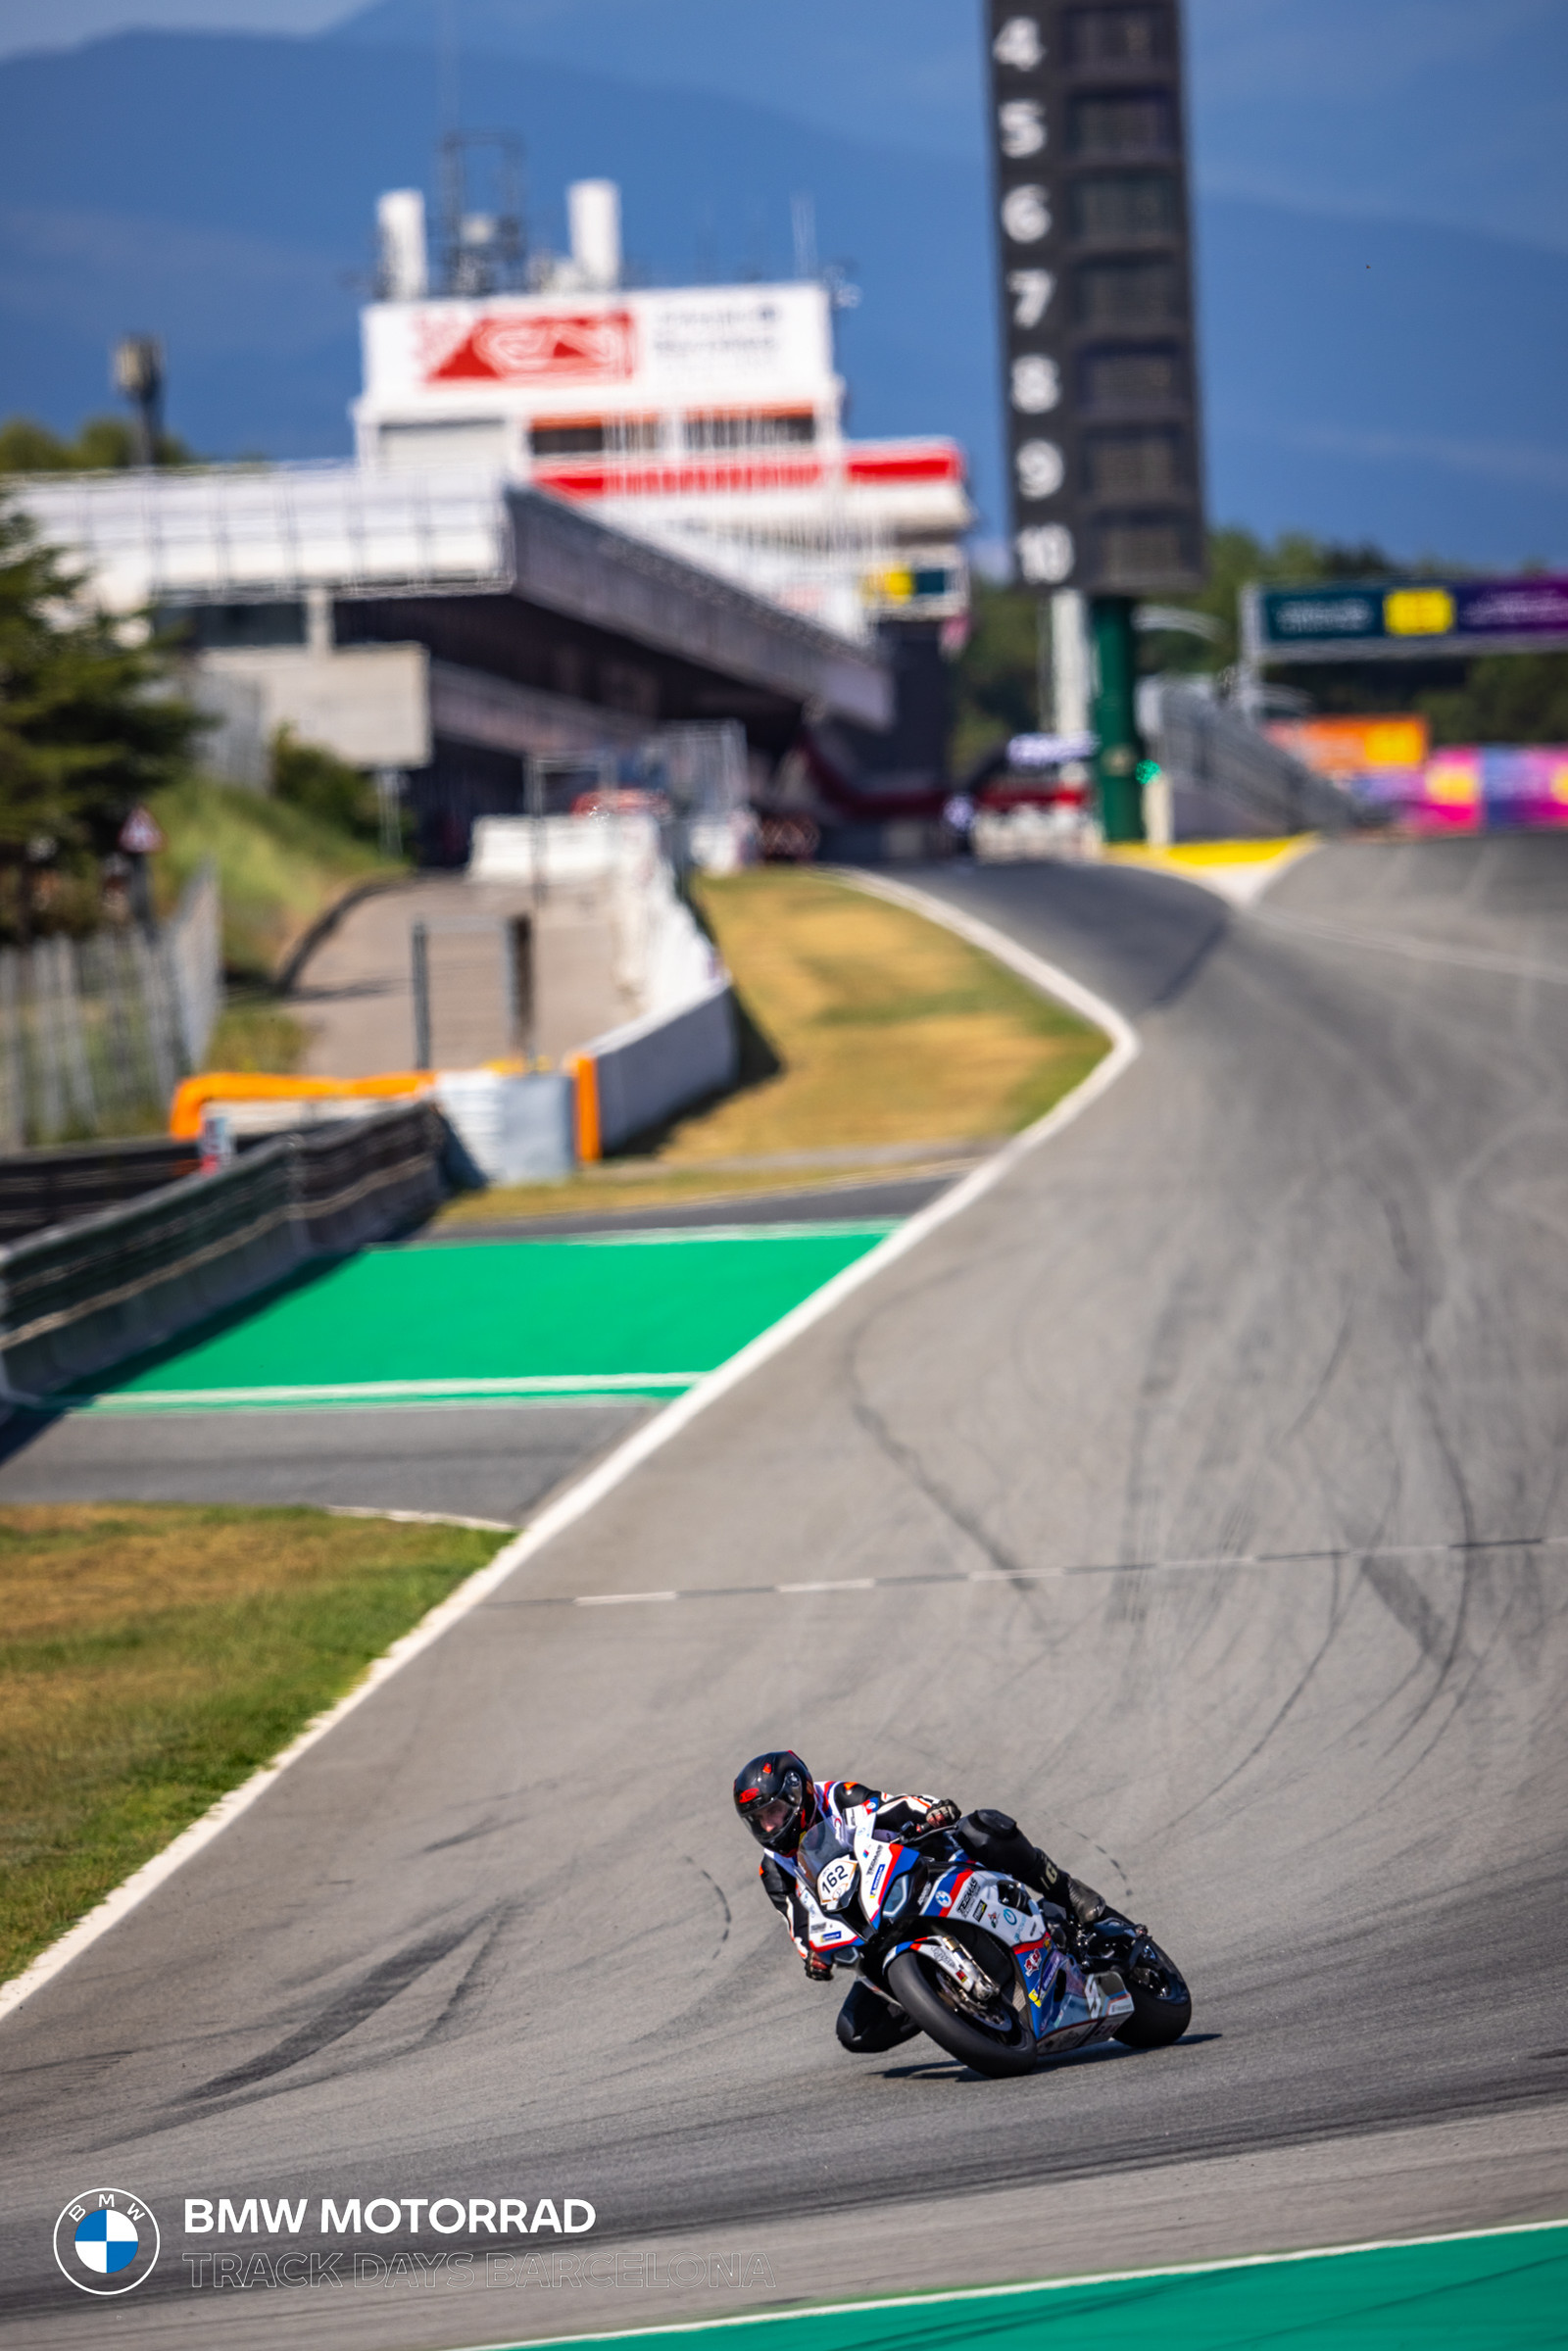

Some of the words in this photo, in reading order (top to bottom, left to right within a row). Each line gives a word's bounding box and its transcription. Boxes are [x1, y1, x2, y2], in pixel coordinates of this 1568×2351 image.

[994, 17, 1046, 71] 4
[1000, 99, 1047, 158] 5
[1003, 184, 1051, 242] 6
[1007, 269, 1055, 328] 7
[1011, 354, 1060, 414] 8
[1016, 439, 1063, 501] 9
[1017, 523, 1074, 584] 10
[822, 1865, 849, 1894] 162
